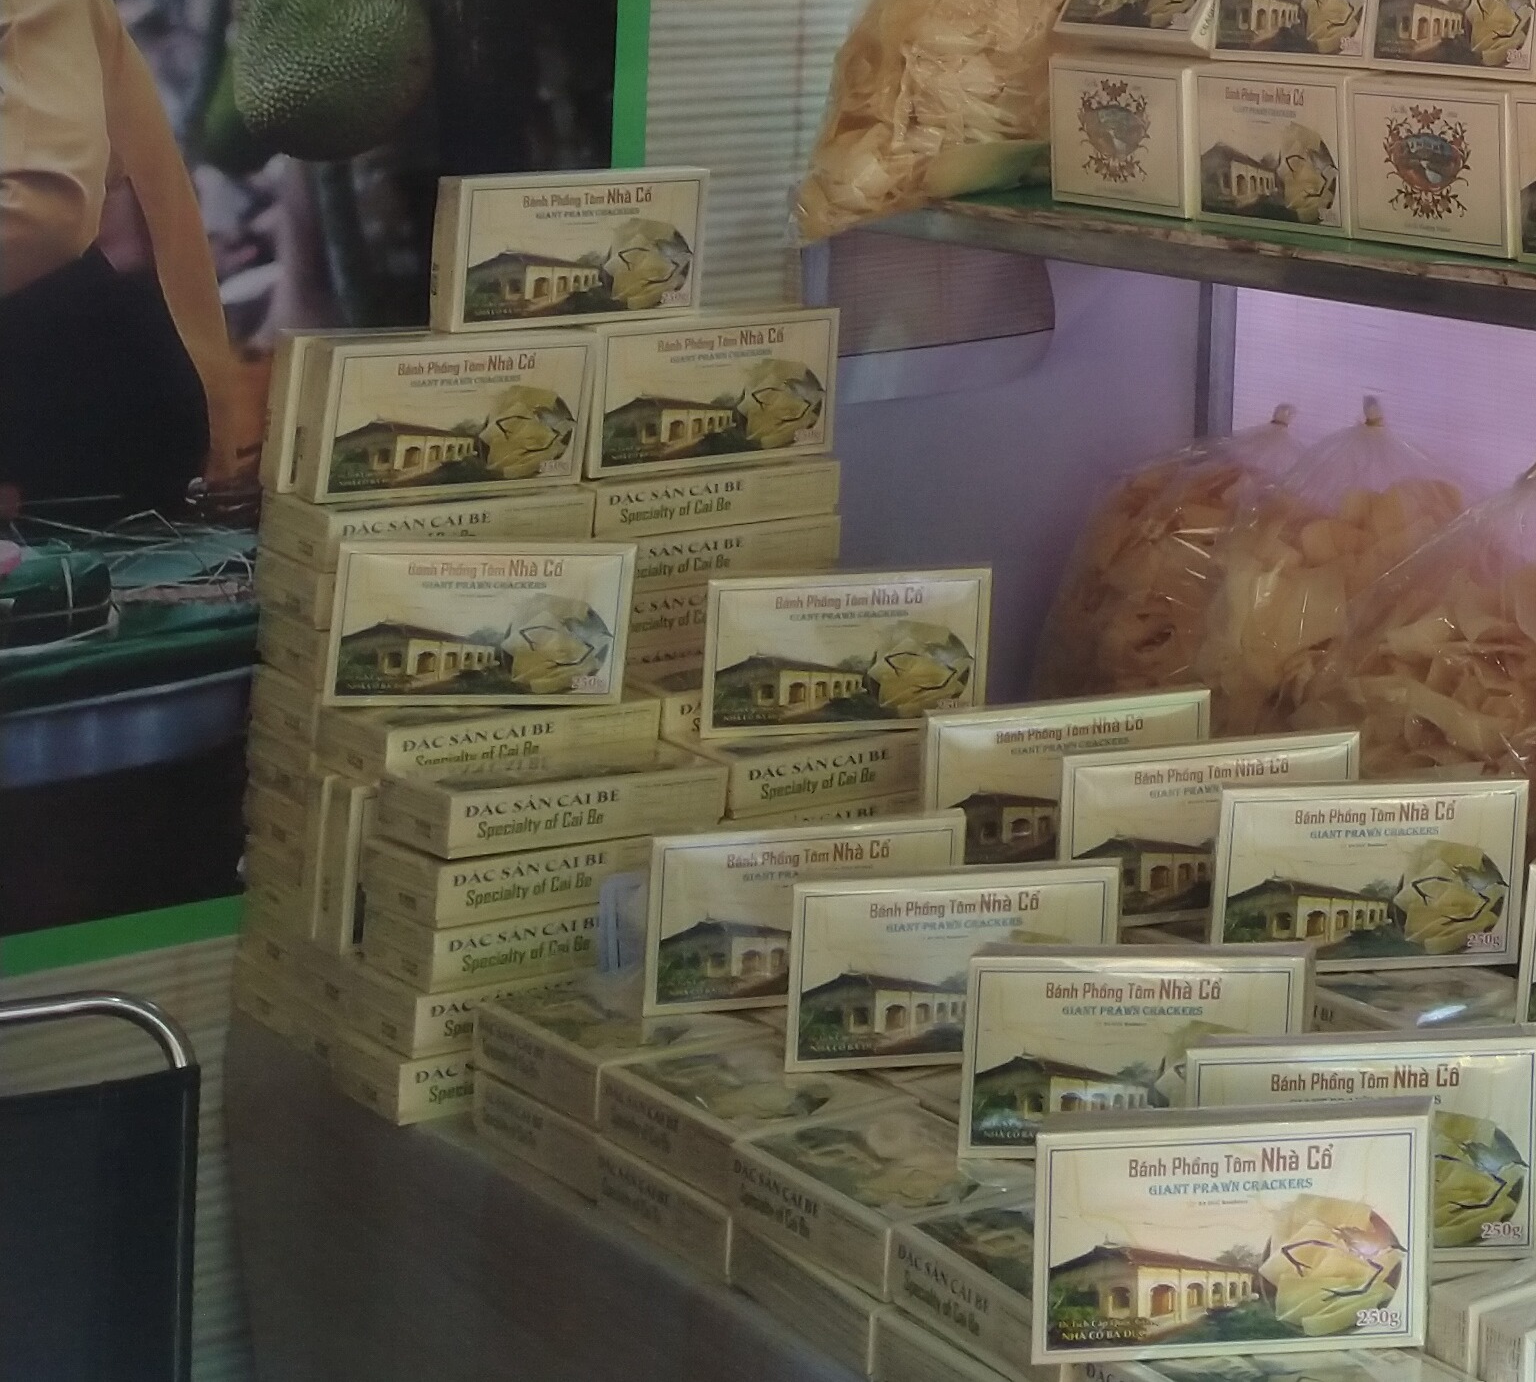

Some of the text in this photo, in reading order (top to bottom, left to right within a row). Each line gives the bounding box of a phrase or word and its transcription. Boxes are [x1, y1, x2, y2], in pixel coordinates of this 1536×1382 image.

[607, 188, 631, 205] Nhà
[1295, 808, 1326, 825] Bánh
[1399, 801, 1430, 823] Nhà
[1271, 1073, 1306, 1092] Bánh
[1393, 1064, 1429, 1090] Nhà
[1128, 1144, 1334, 1178] Bánh Phồng Tôm Nhà Cổ
[1148, 1178, 1313, 1195] GIANT PRAWN CRACKERS
[1481, 1222, 1522, 1242] 250g
[1356, 1308, 1400, 1329] 250g
